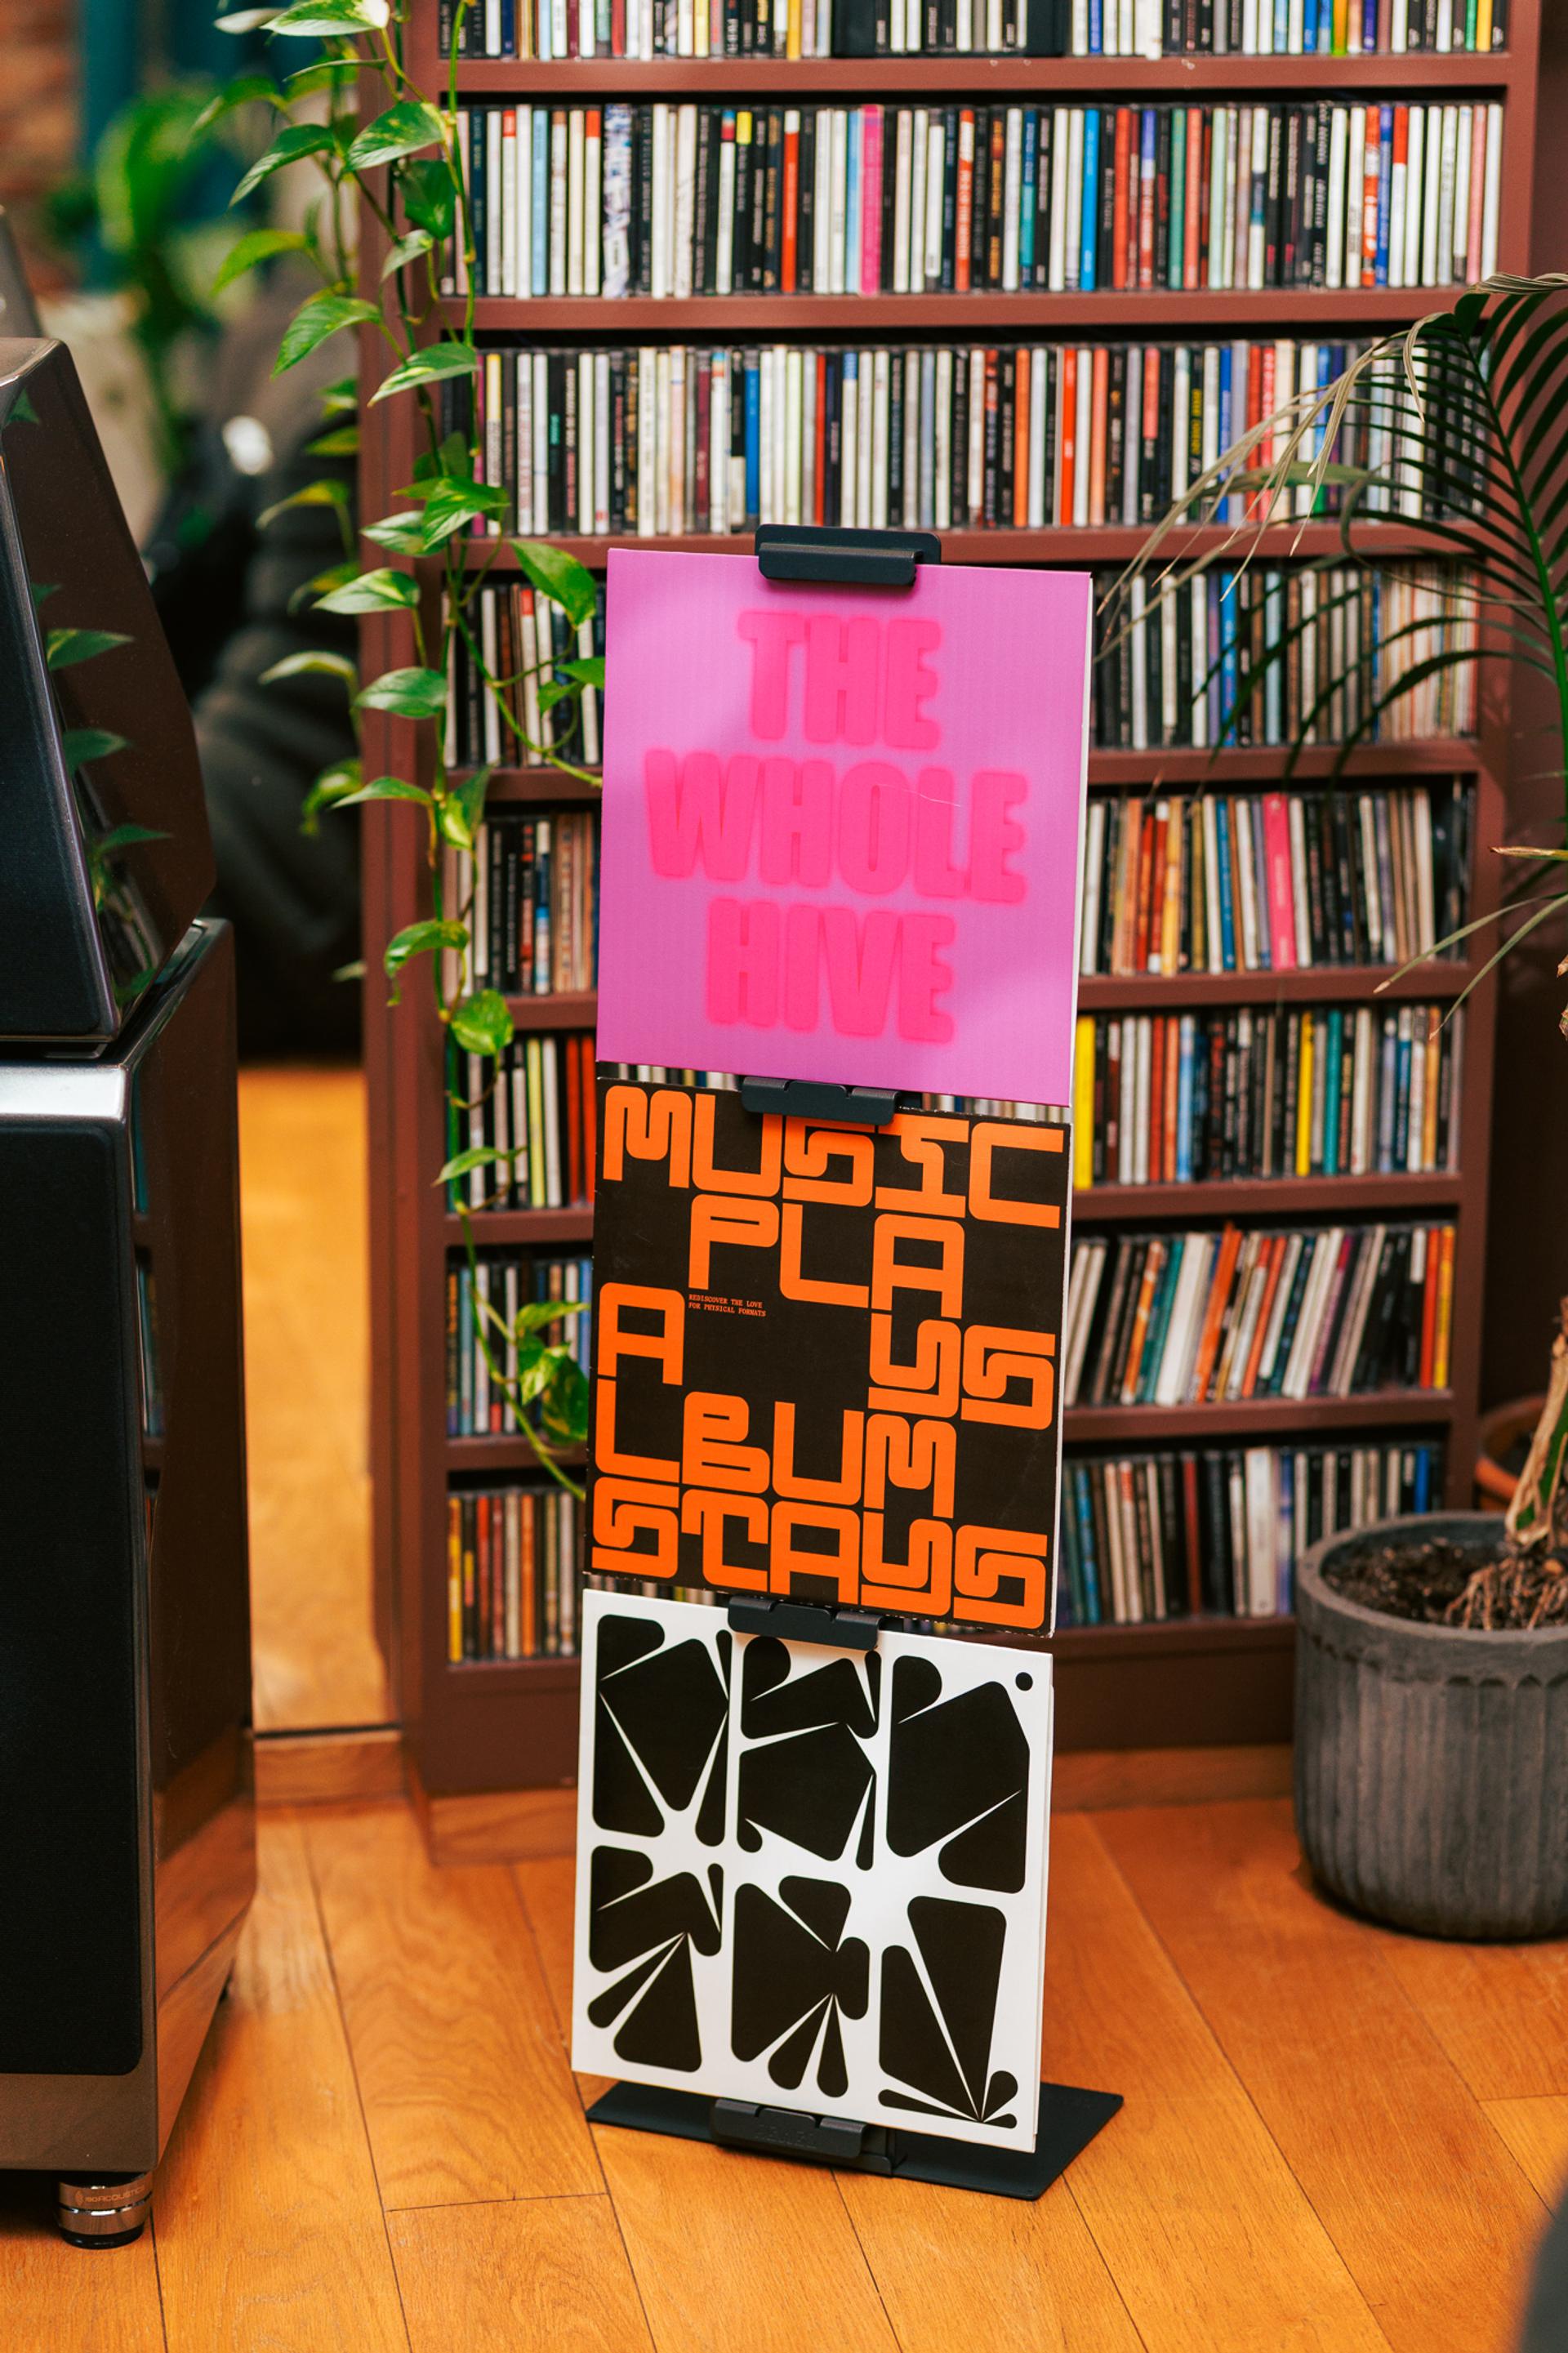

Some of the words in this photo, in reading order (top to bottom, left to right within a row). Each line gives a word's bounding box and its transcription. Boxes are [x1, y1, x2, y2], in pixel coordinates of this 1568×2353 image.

[739, 613, 941, 749] THE
[645, 750, 1028, 902] WHOLE
[707, 898, 956, 1043] HIVE
[603, 1085, 1064, 1228] MUSIC
[688, 1295, 728, 1304] REDISCOVER
[704, 1304, 735, 1313] PHYSICAL
[738, 1308, 766, 1317] FORMATS
